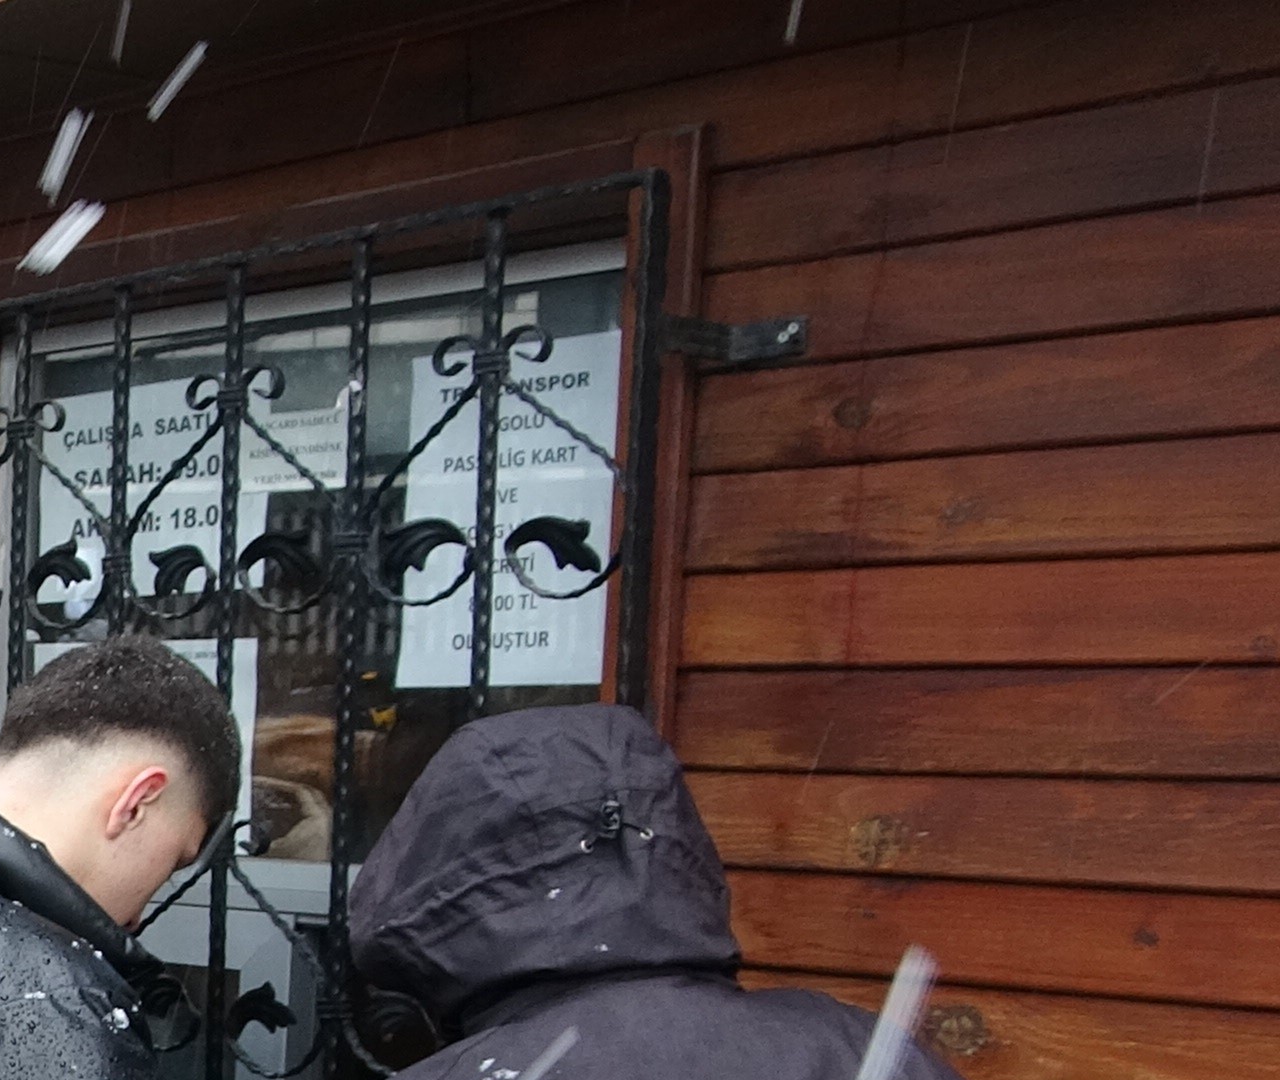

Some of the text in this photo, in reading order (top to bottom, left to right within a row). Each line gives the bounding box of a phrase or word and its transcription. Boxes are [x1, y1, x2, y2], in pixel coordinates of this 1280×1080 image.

[441, 371, 590, 403] TRONSPOR
[498, 414, 545, 432] GOLU
[64, 423, 143, 452] ÇALIŞA
[171, 454, 220, 479] 9.0
[444, 446, 579, 473] PASLİG KART
[497, 487, 518, 504] VE
[72, 504, 219, 538] AKM: 18.0
[492, 552, 536, 574] CRTİ
[520, 594, 538, 610] TL
[452, 631, 549, 652] OLUŞTUR
